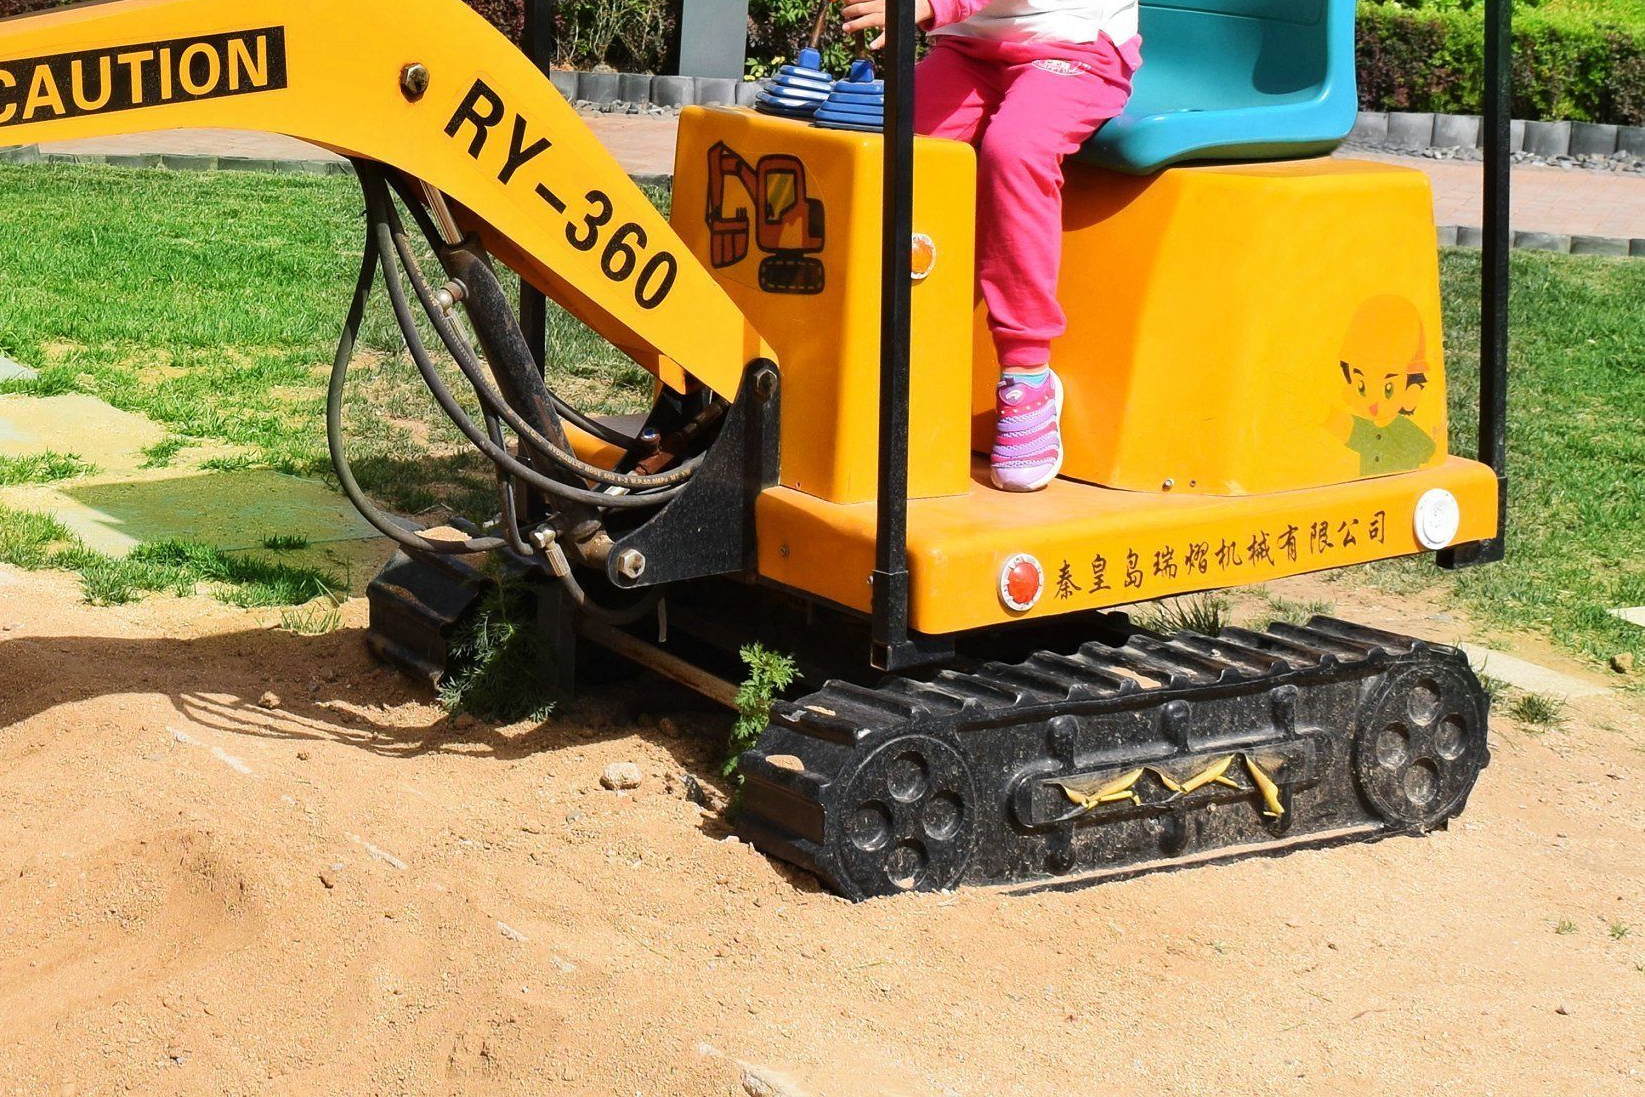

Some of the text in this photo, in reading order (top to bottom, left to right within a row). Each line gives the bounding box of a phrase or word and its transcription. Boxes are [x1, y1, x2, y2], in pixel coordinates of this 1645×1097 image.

[443, 77, 679, 311] RY-360
[1053, 510, 1387, 601] 秦皇岛瑞熠机械有限公司
